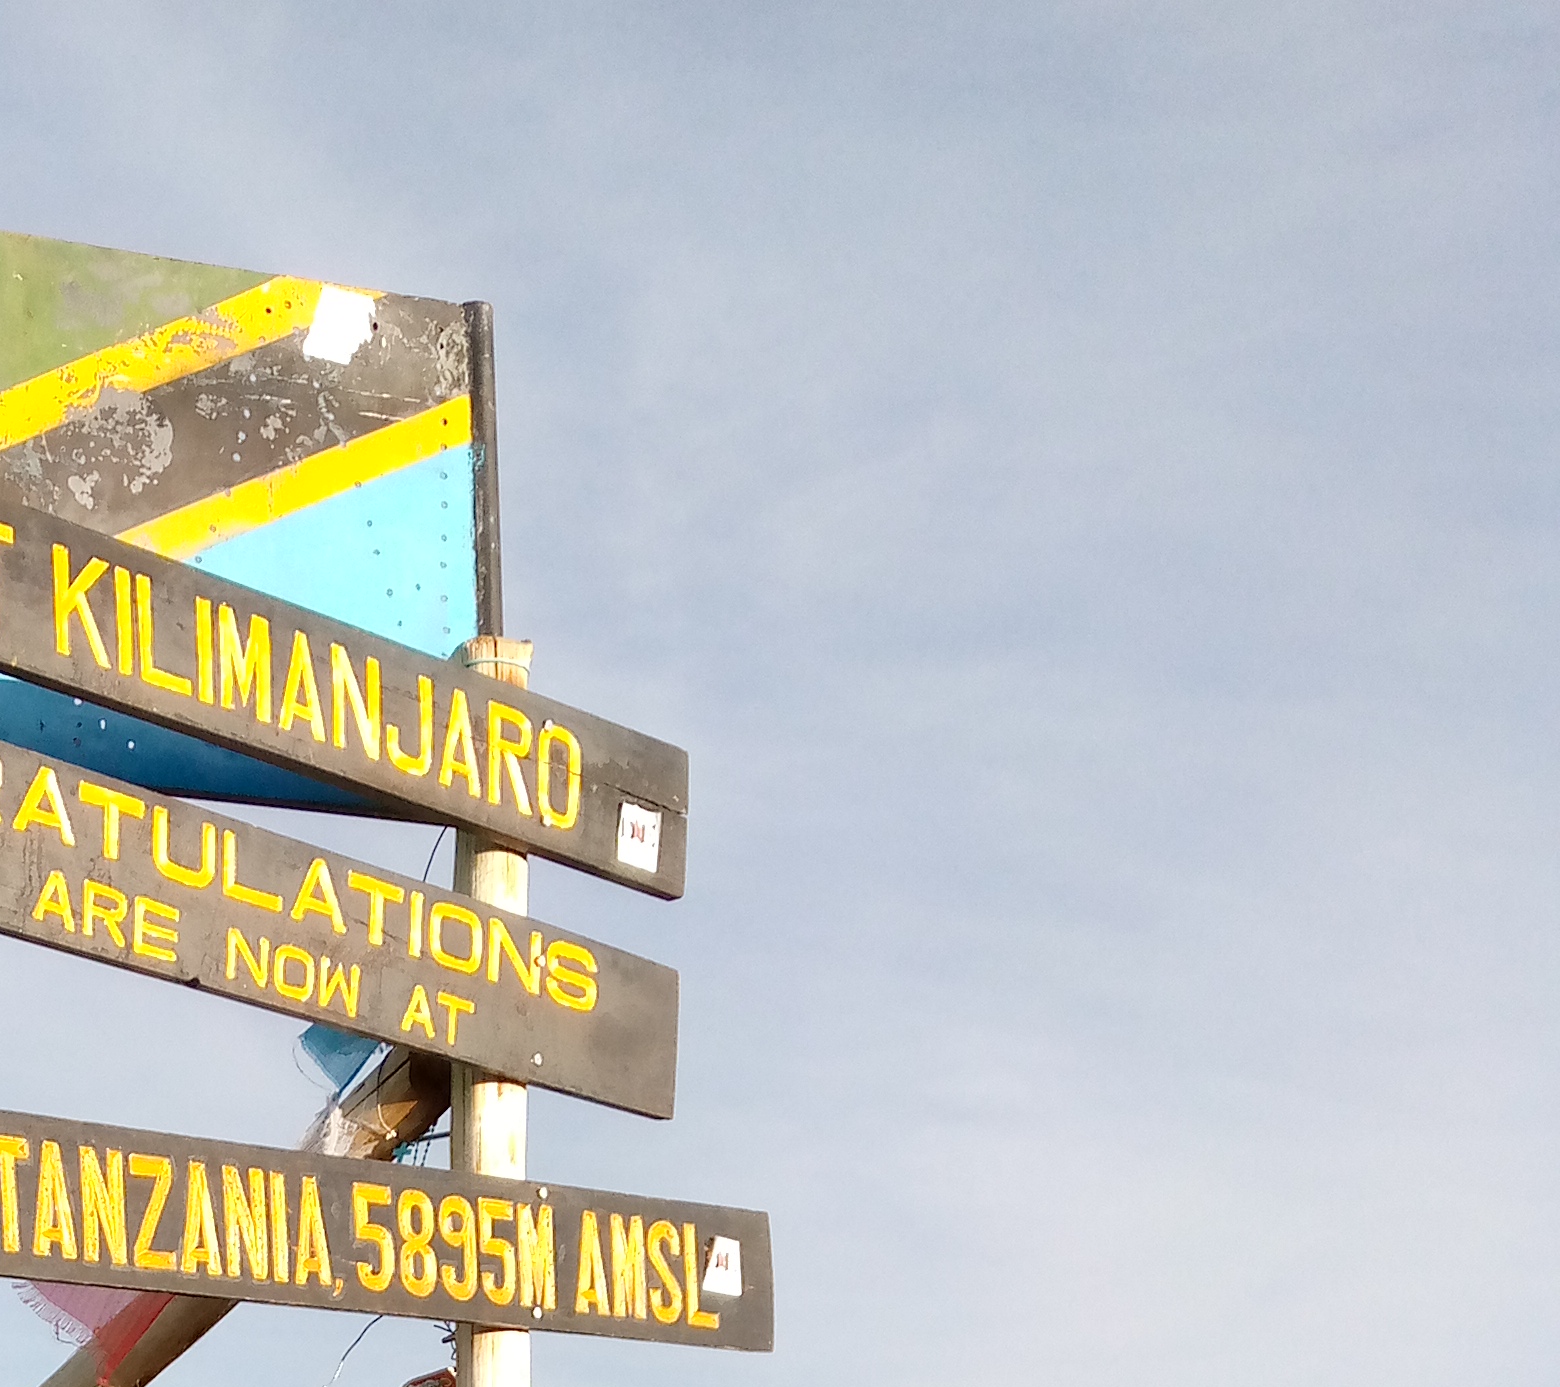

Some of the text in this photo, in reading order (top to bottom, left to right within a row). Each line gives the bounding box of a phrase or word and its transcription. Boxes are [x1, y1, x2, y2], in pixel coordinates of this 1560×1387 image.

[51, 543, 583, 831] KILIMANJARO
[30, 870, 180, 963] ARE
[226, 927, 359, 1018] NOW
[401, 984, 476, 1047] AT
[350, 1181, 558, 1312] 5895M
[574, 1209, 721, 1331] AMSL
